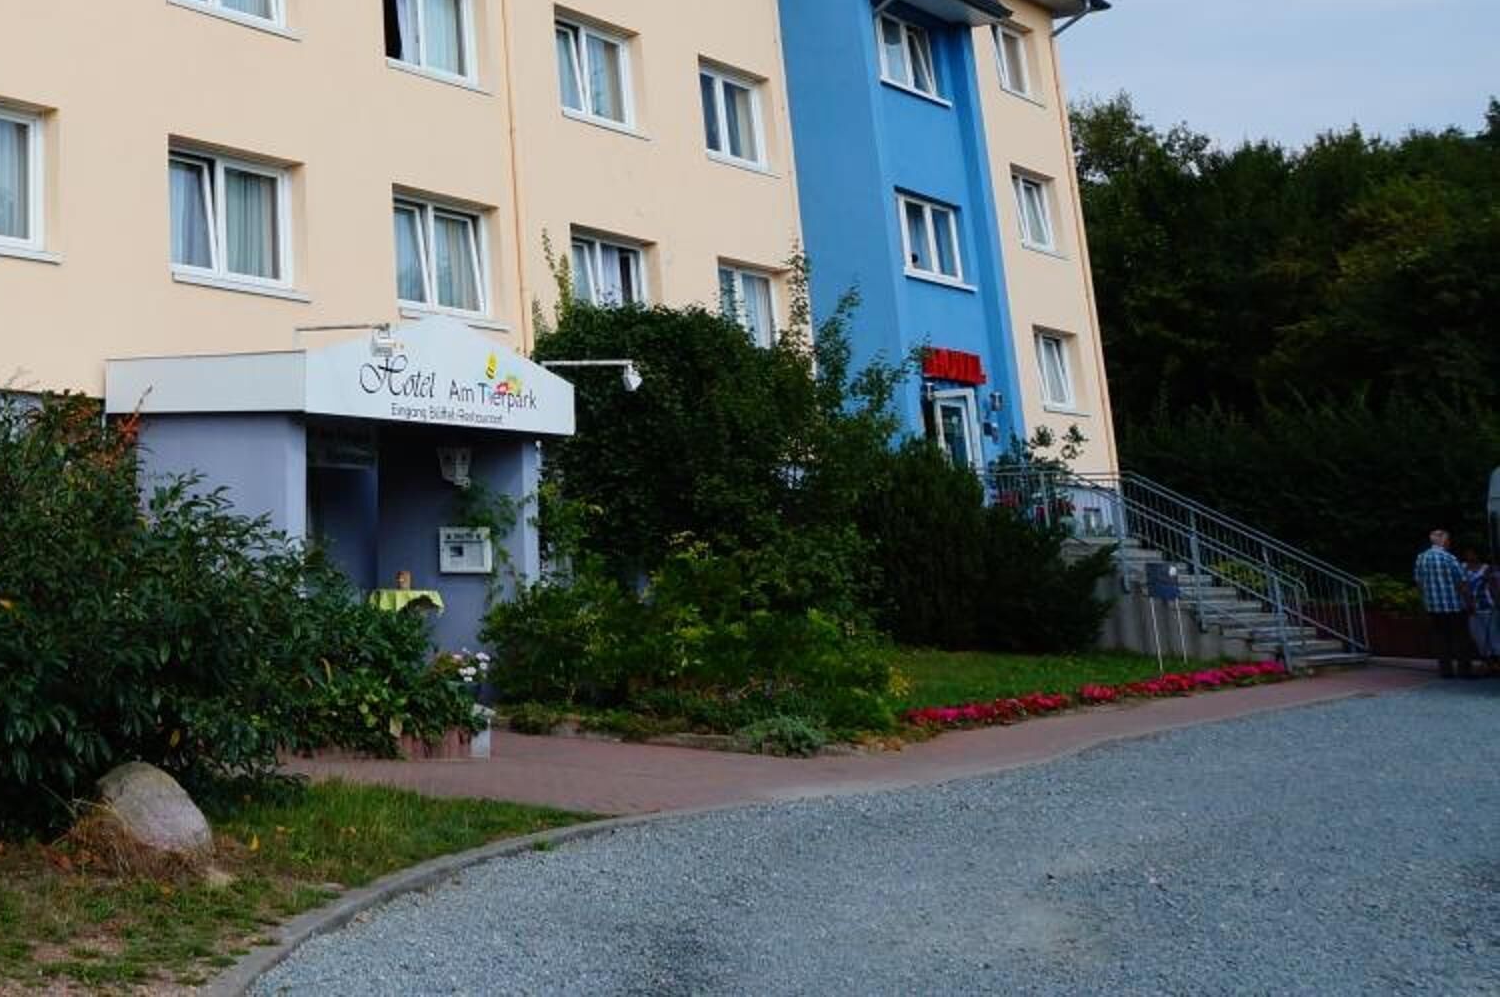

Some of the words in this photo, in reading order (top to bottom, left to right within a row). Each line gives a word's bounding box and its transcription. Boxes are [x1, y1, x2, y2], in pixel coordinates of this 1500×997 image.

[359, 354, 436, 399] Hotel
[450, 379, 475, 404] Am
[478, 381, 537, 413] Tierpark
[391, 402, 427, 421] Eingang
